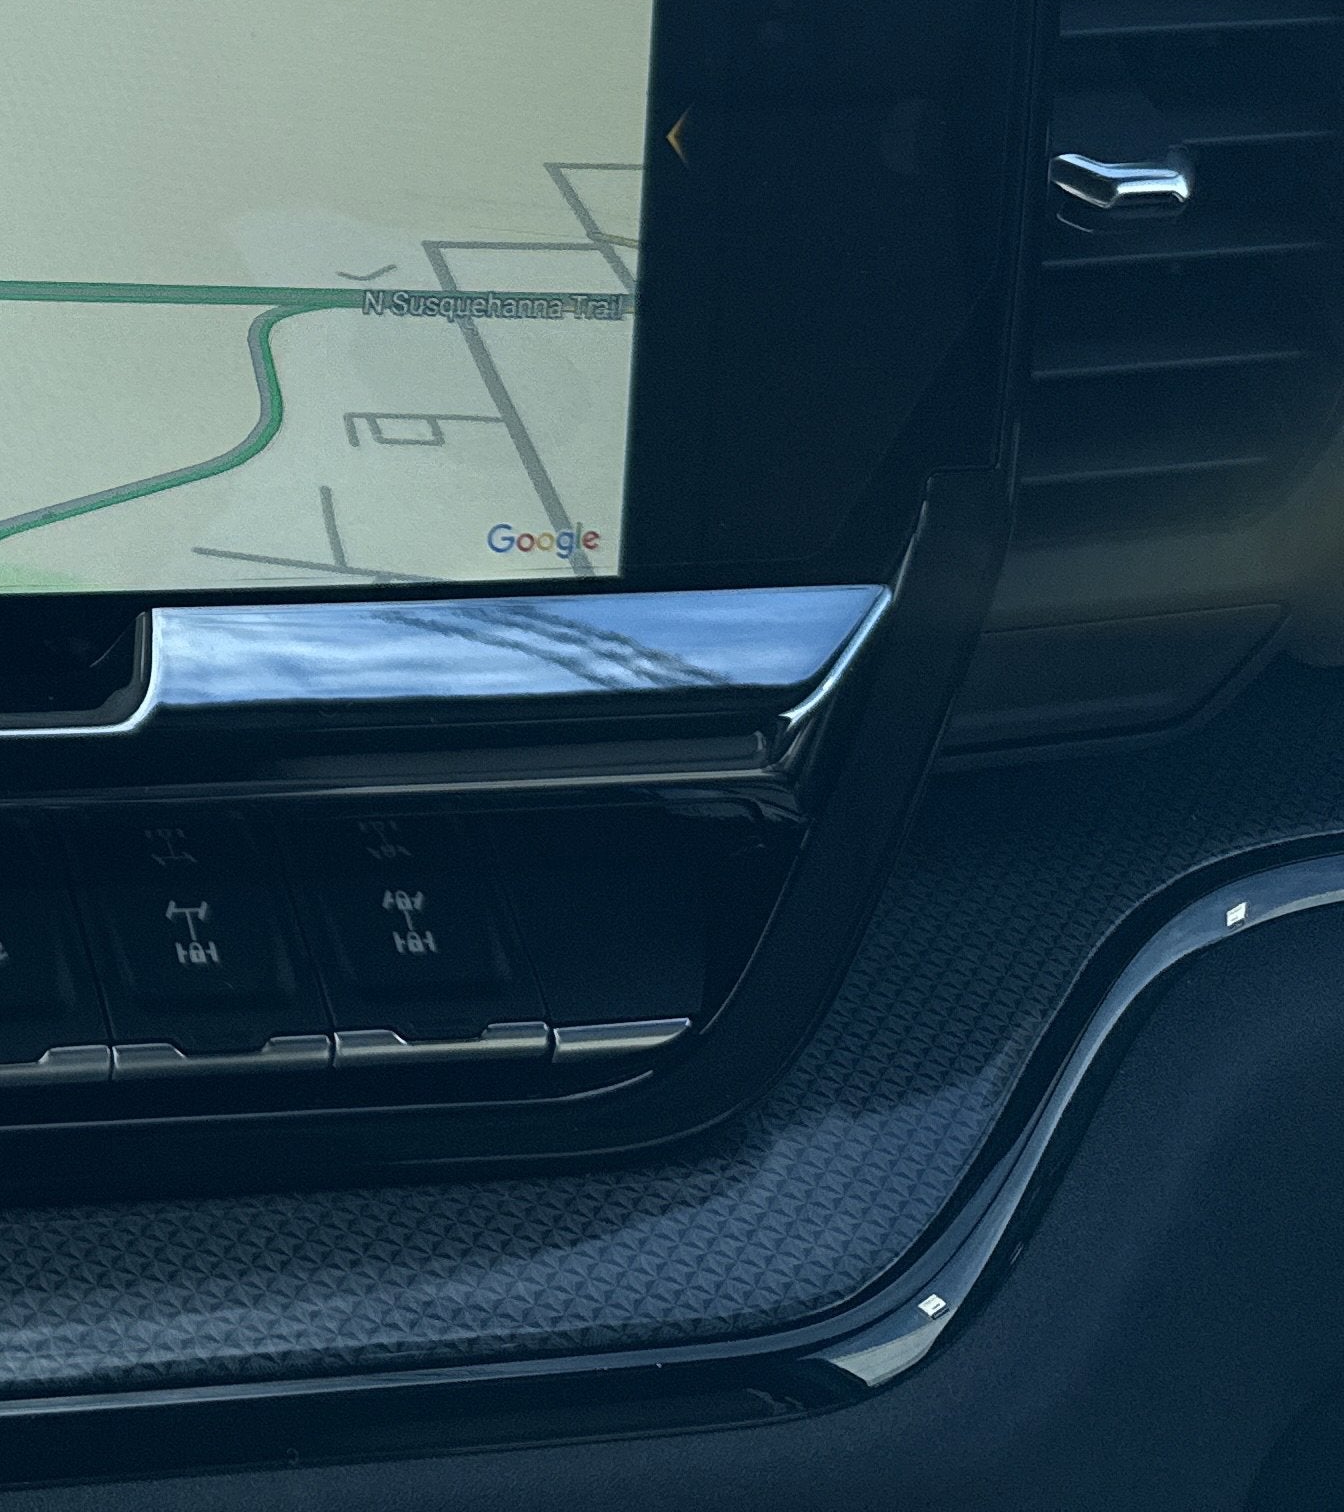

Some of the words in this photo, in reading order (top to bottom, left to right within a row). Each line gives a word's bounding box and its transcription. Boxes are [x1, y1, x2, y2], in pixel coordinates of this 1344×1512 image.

[362, 291, 383, 314] N
[391, 291, 564, 322] Susquehanna
[568, 294, 623, 320] Trail
[487, 522, 601, 559] Google
